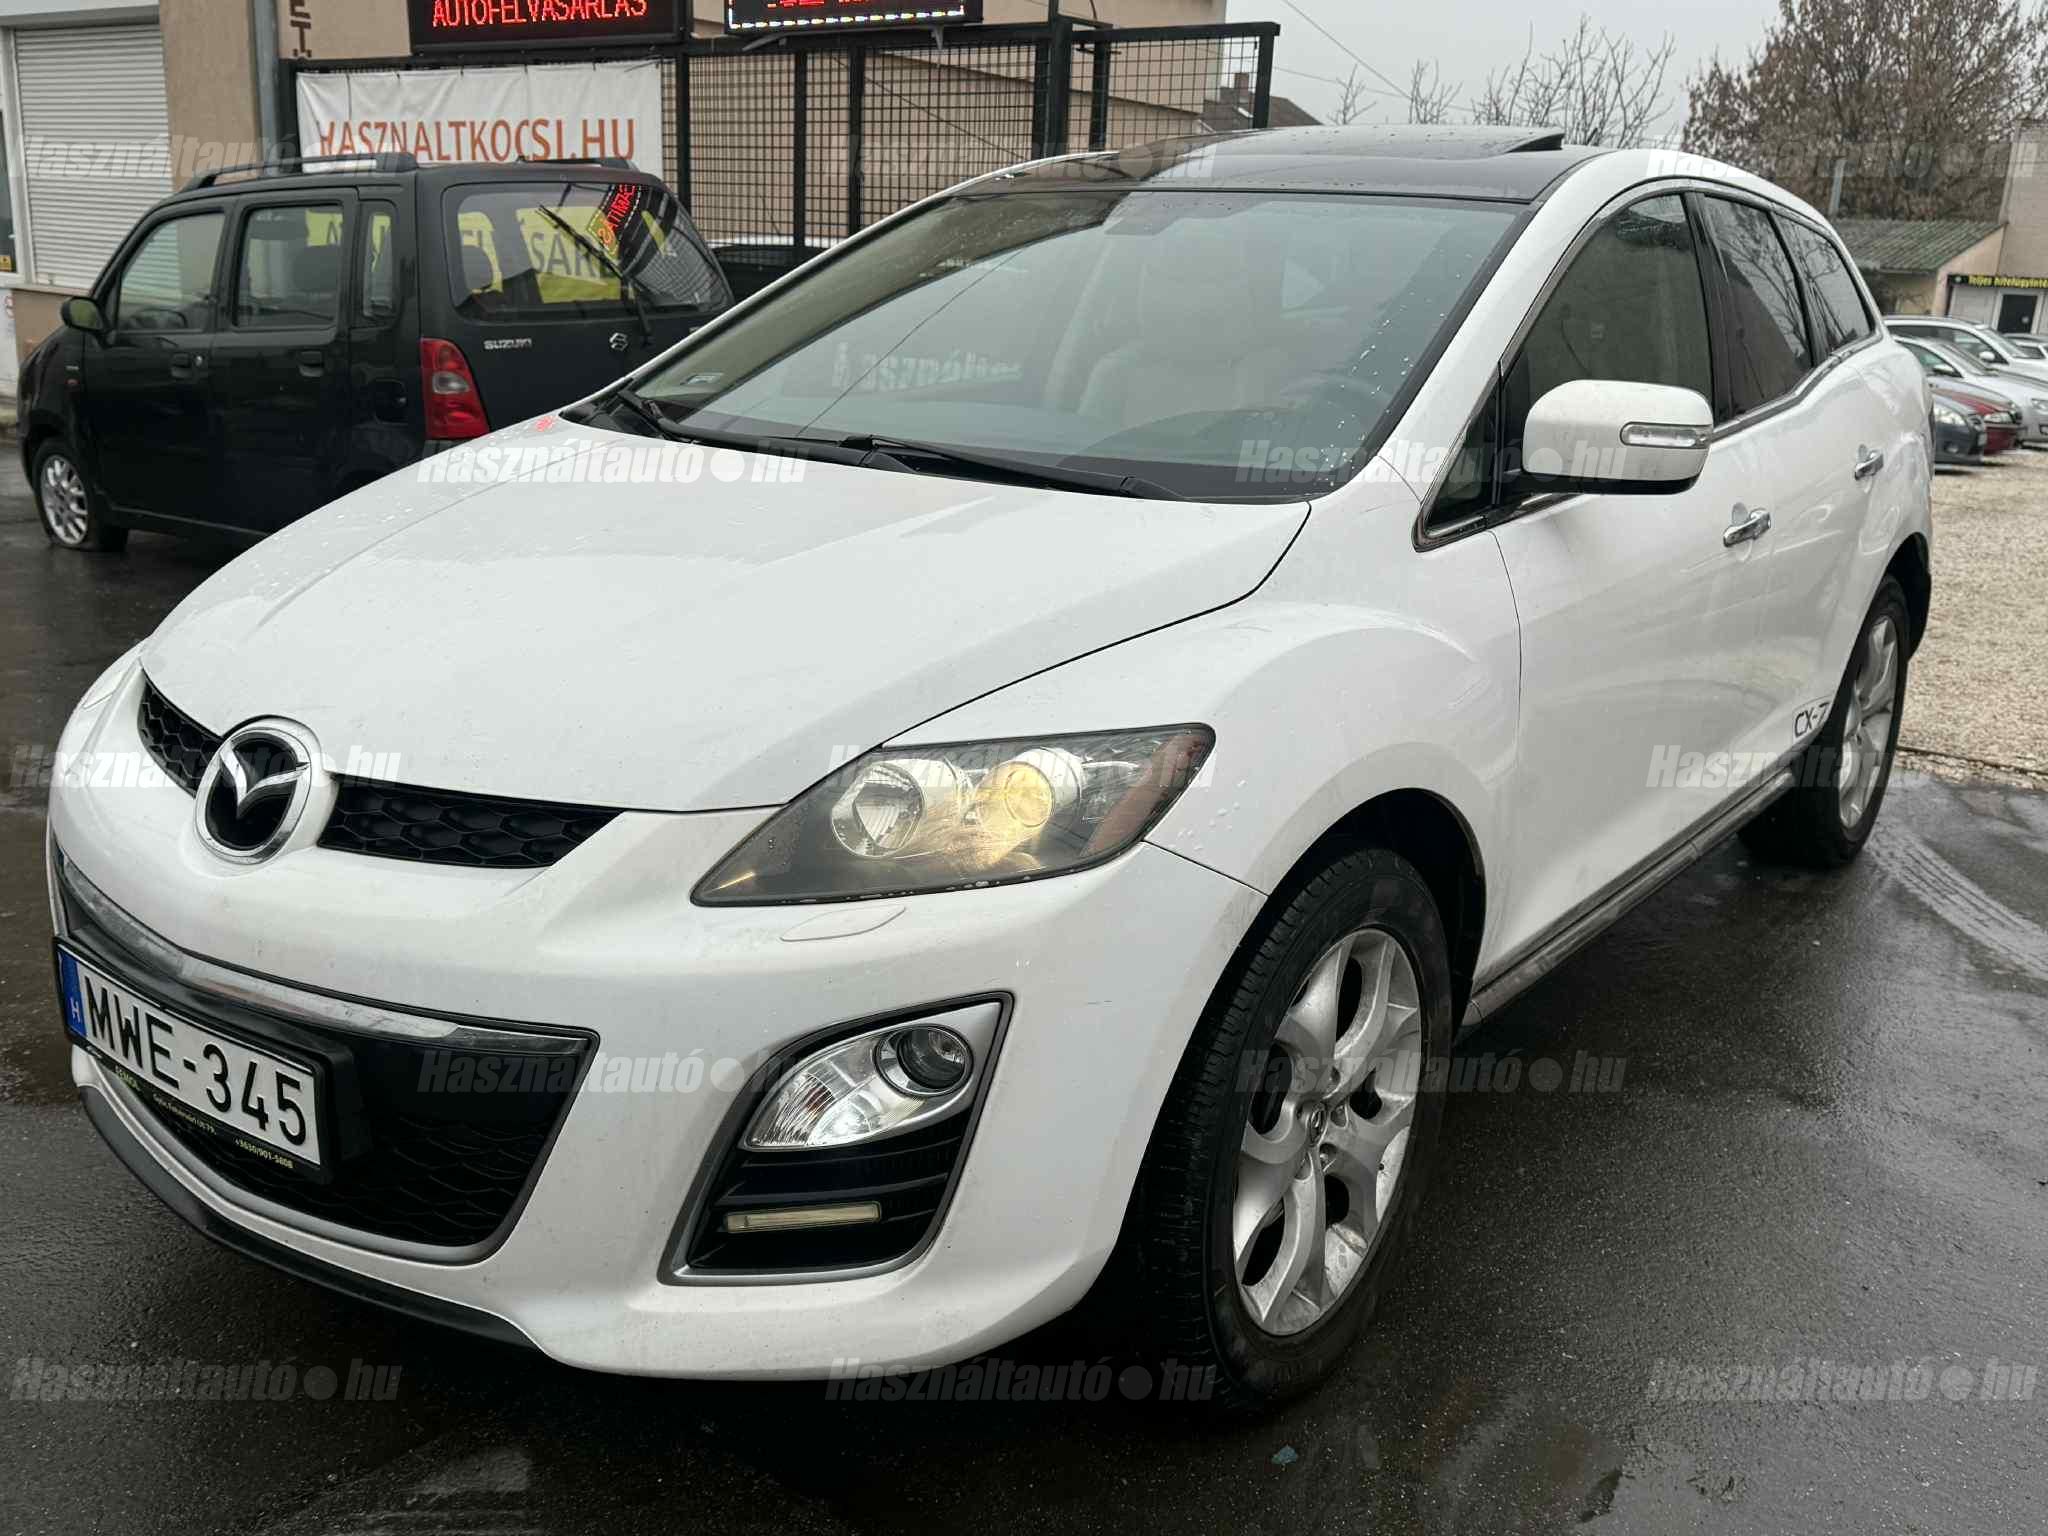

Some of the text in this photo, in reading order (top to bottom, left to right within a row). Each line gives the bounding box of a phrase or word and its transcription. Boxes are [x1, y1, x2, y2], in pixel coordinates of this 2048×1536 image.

[483, 337, 532, 350] SUZUKI
[1794, 702, 1830, 738] CX-7
[84, 975, 307, 1146] MWE-345
